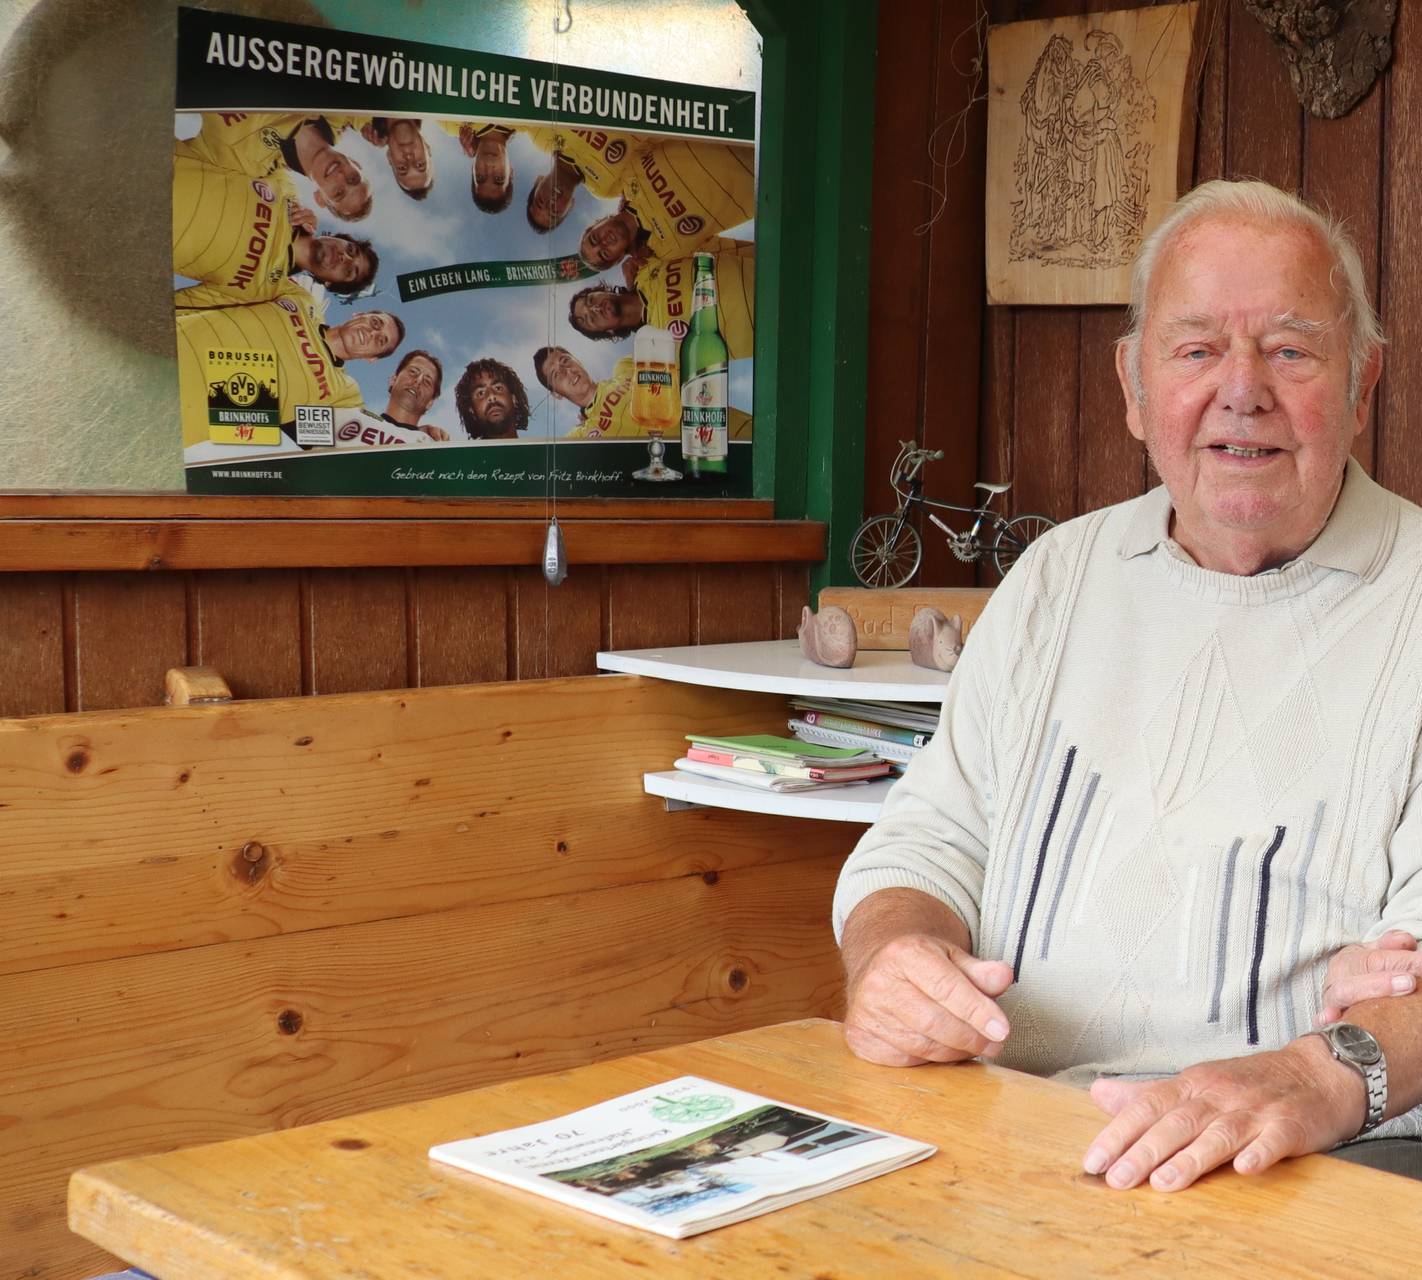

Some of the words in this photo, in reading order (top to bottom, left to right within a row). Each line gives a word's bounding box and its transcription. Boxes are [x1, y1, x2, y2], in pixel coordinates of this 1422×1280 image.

[206, 31, 521, 106] AUSSERGEWÖHNLICHE
[530, 78, 734, 133] VERBUNDENHEIT.
[408, 277, 428, 293] EIN
[431, 272, 462, 289] LEBEN
[208, 350, 274, 363] BORUSSIA
[230, 375, 256, 396] BVB
[297, 408, 331, 422] BIER
[391, 467, 436, 481] Gebraut
[438, 469, 464, 481] nach
[467, 471, 488, 481] dem
[491, 469, 526, 484] Rezept
[528, 473, 546, 481] von
[549, 469, 572, 482] Fritz
